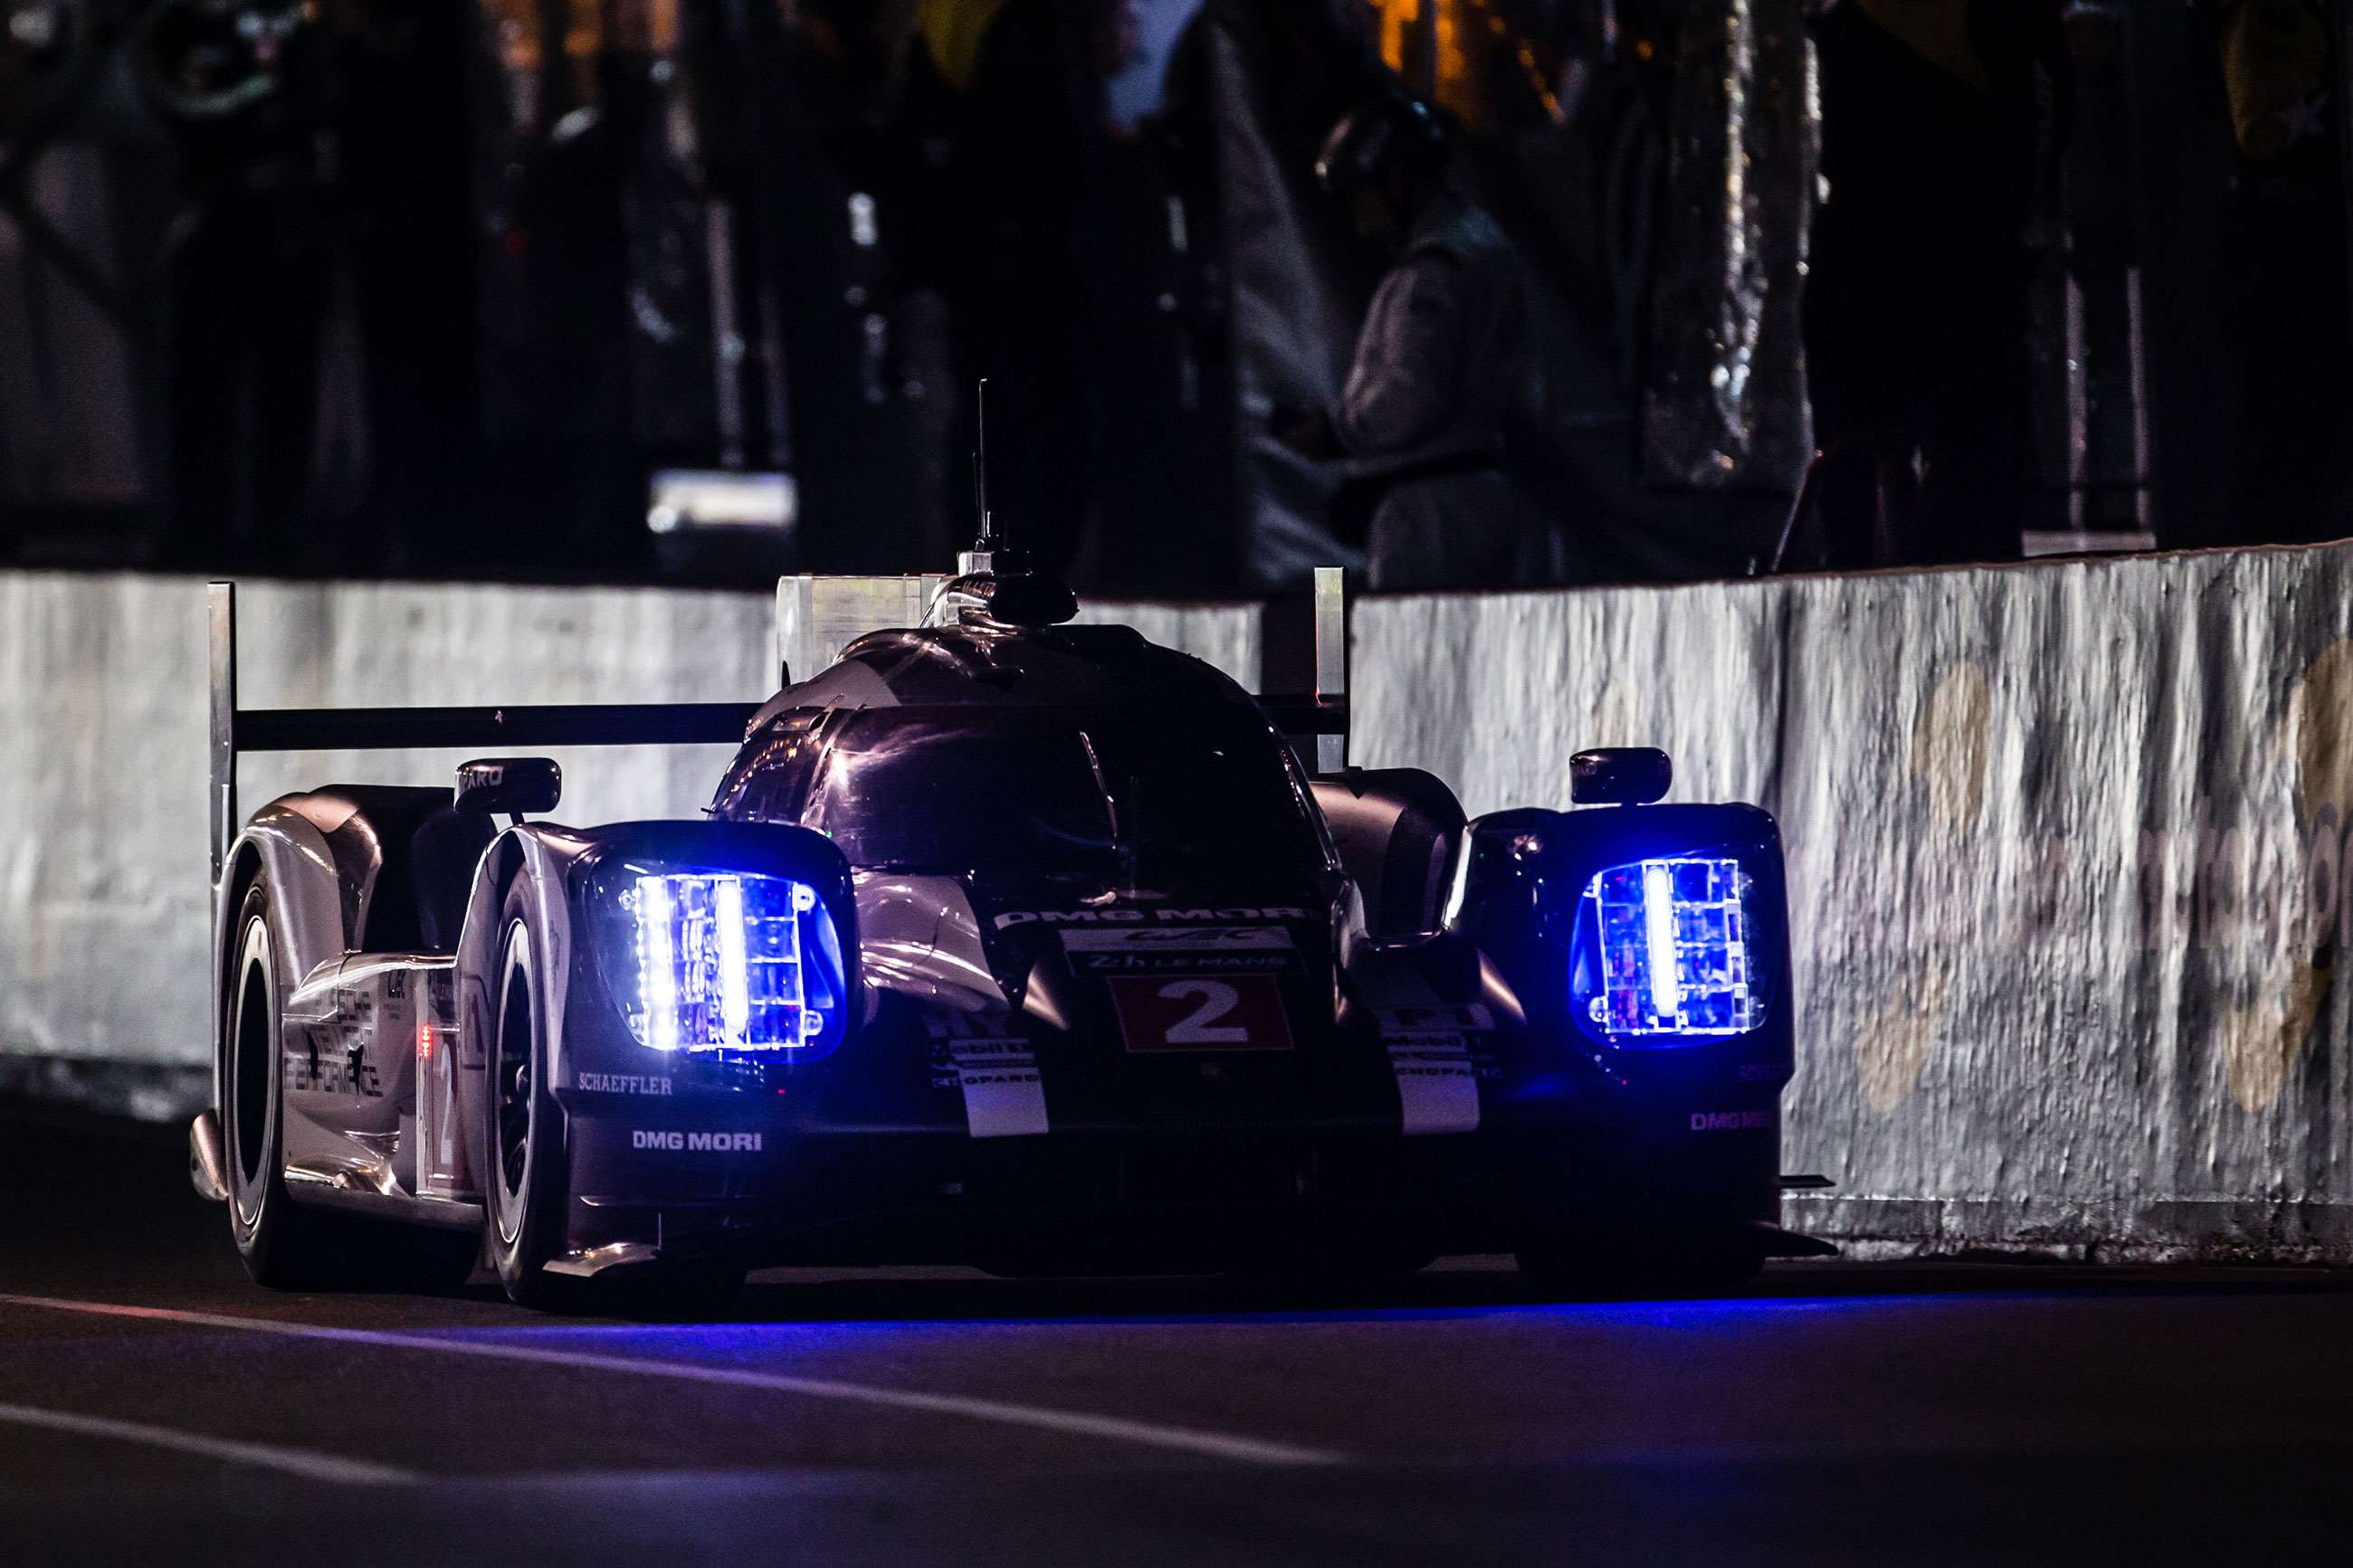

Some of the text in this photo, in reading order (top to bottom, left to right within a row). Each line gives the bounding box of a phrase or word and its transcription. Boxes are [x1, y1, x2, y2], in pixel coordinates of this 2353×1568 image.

[994, 910, 1144, 930] DMG
[1157, 979, 1249, 1044] 2
[578, 1071, 672, 1096] SCHAEFFLER
[440, 1041, 453, 1164] 2
[633, 1130, 762, 1152] DMG MORI
